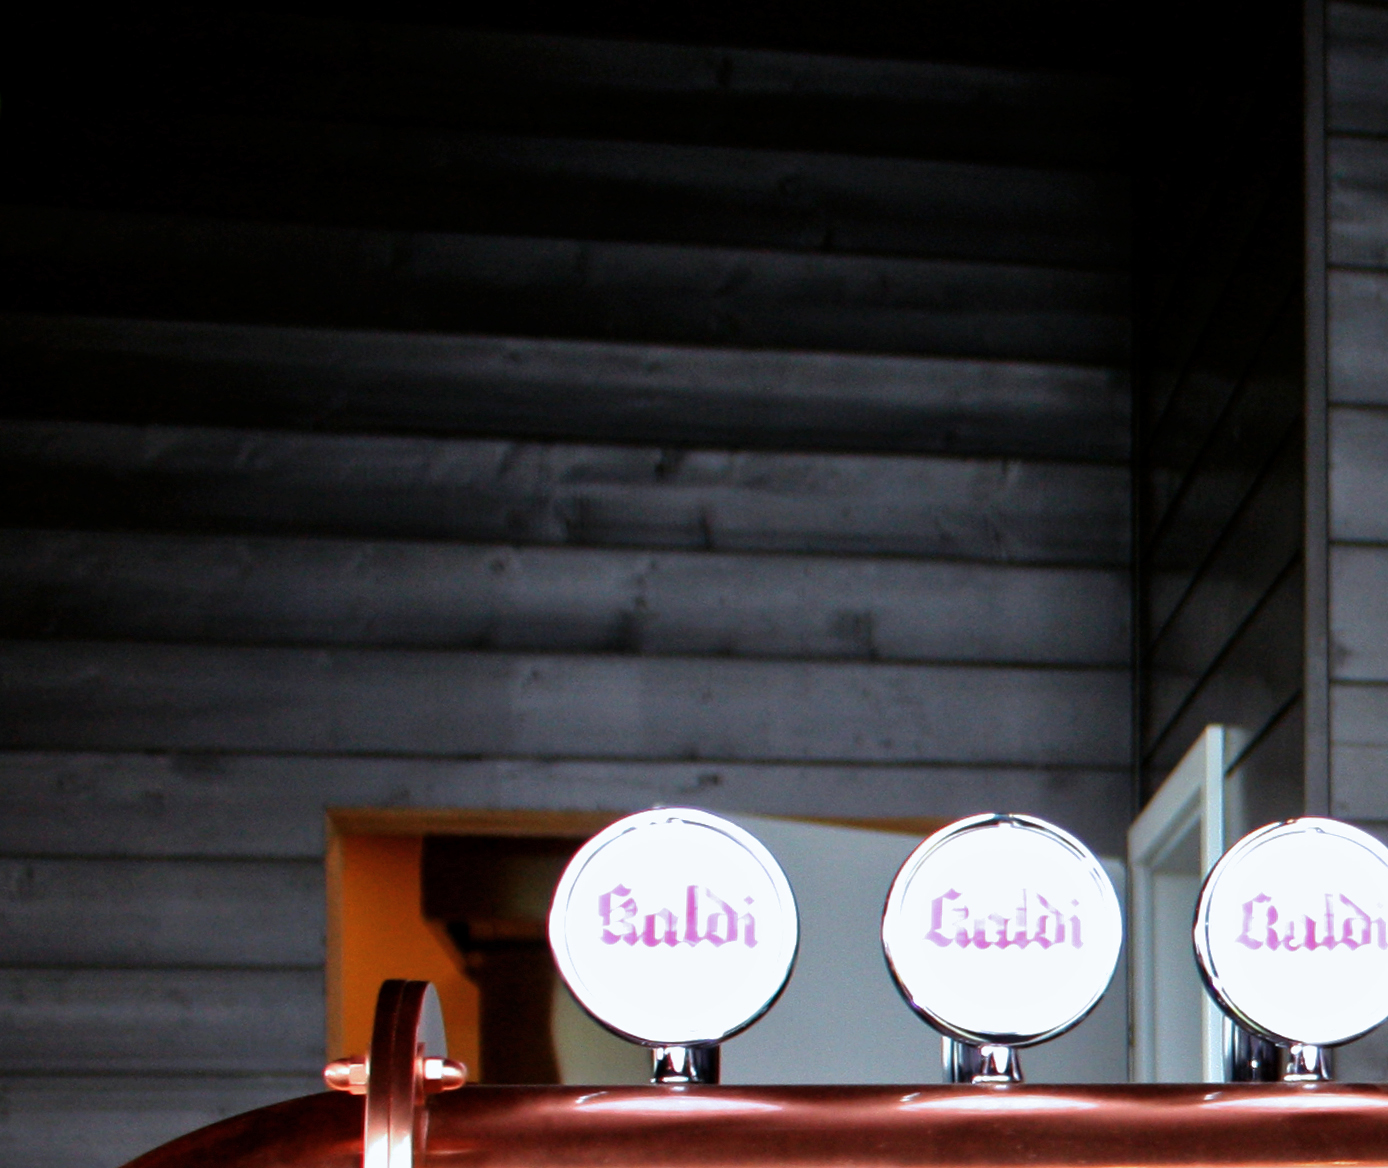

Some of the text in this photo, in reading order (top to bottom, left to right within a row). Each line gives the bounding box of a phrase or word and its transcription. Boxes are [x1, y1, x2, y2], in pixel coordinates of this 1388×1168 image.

[597, 884, 758, 948] Kaldi
[925, 888, 1082, 950] Kaldi
[1236, 893, 1388, 952] Kaldi
